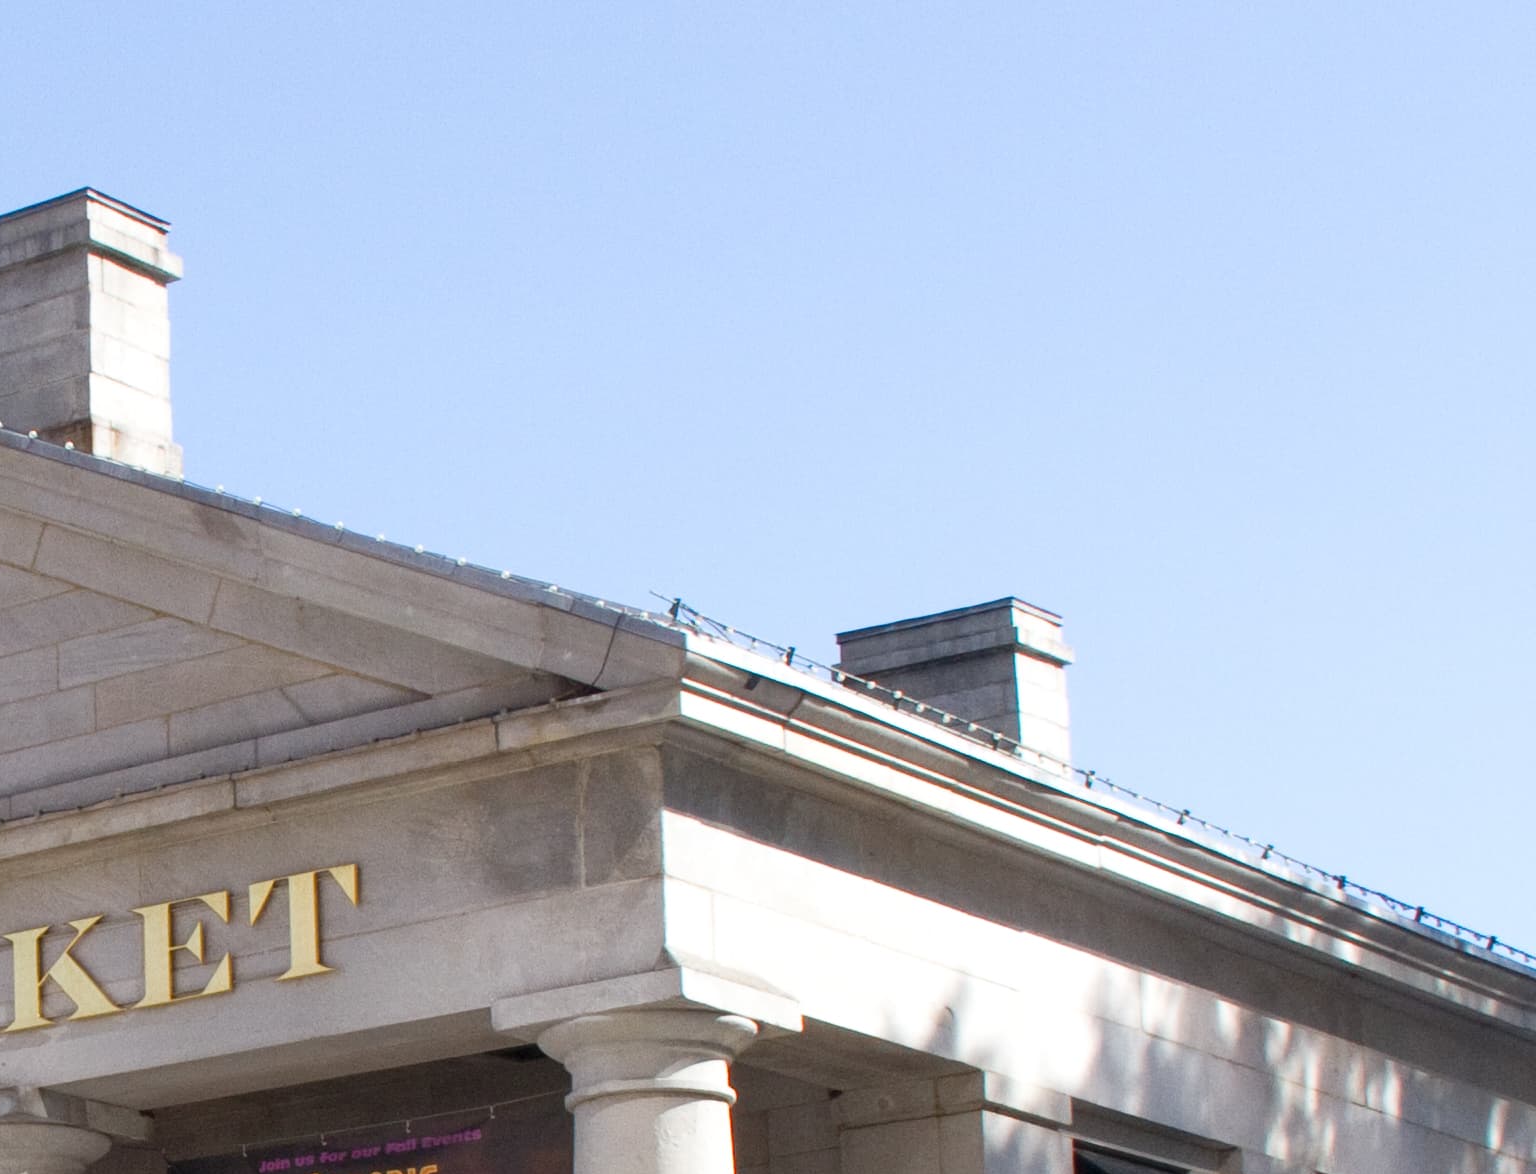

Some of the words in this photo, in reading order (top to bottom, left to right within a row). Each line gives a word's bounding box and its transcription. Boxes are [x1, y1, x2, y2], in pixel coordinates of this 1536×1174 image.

[259, 1156, 291, 1174] Join
[295, 1156, 314, 1168] us
[352, 1146, 381, 1159] our
[421, 1128, 482, 1149] Events
